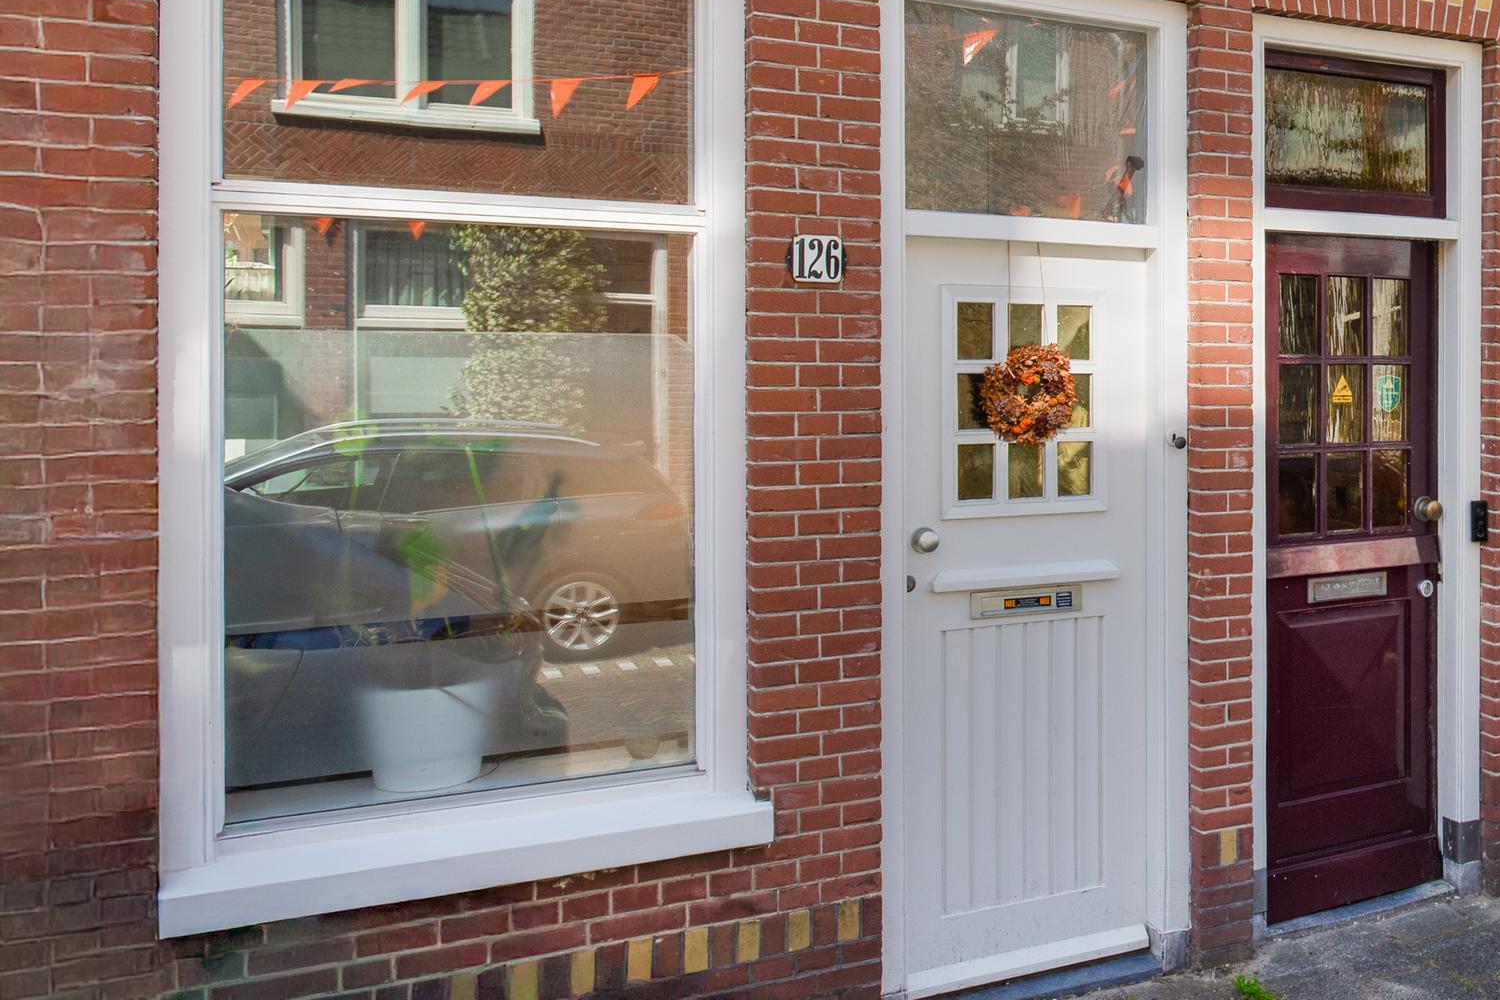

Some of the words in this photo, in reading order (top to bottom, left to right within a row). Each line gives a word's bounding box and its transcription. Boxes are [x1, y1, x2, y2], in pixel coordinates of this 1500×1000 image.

[795, 238, 840, 279] 126
[1005, 599, 1017, 608] NEE
[1039, 596, 1051, 605] NEE
